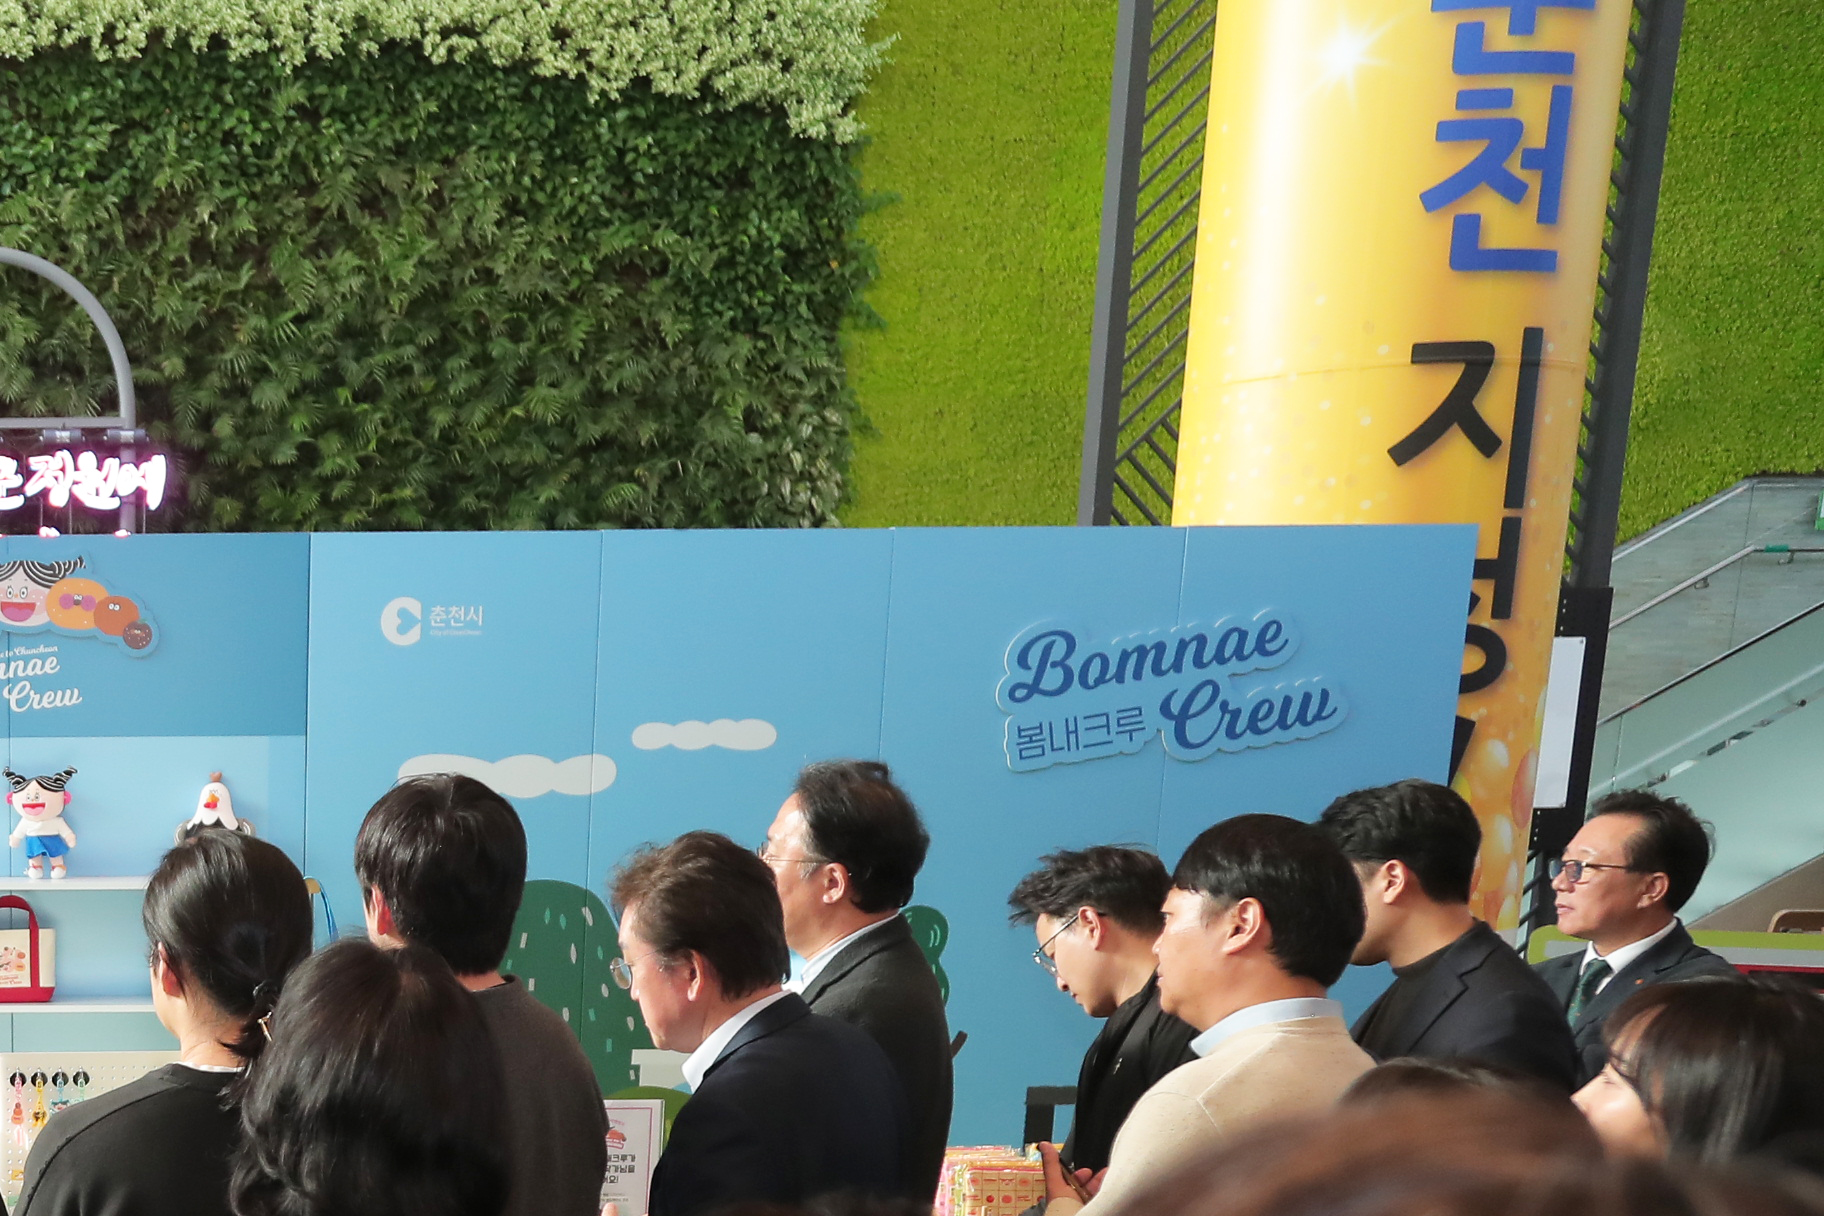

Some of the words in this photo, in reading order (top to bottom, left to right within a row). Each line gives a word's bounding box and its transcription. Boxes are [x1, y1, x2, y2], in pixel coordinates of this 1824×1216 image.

[429, 605, 484, 627] 춘천시
[5, 649, 14, 658] to
[14, 644, 58, 656] Chuncheon
[1008, 619, 1289, 703] Bomnae
[2, 681, 83, 713] Crew
[1159, 679, 1338, 750] Crew
[1016, 706, 1147, 761] 봄내크루
